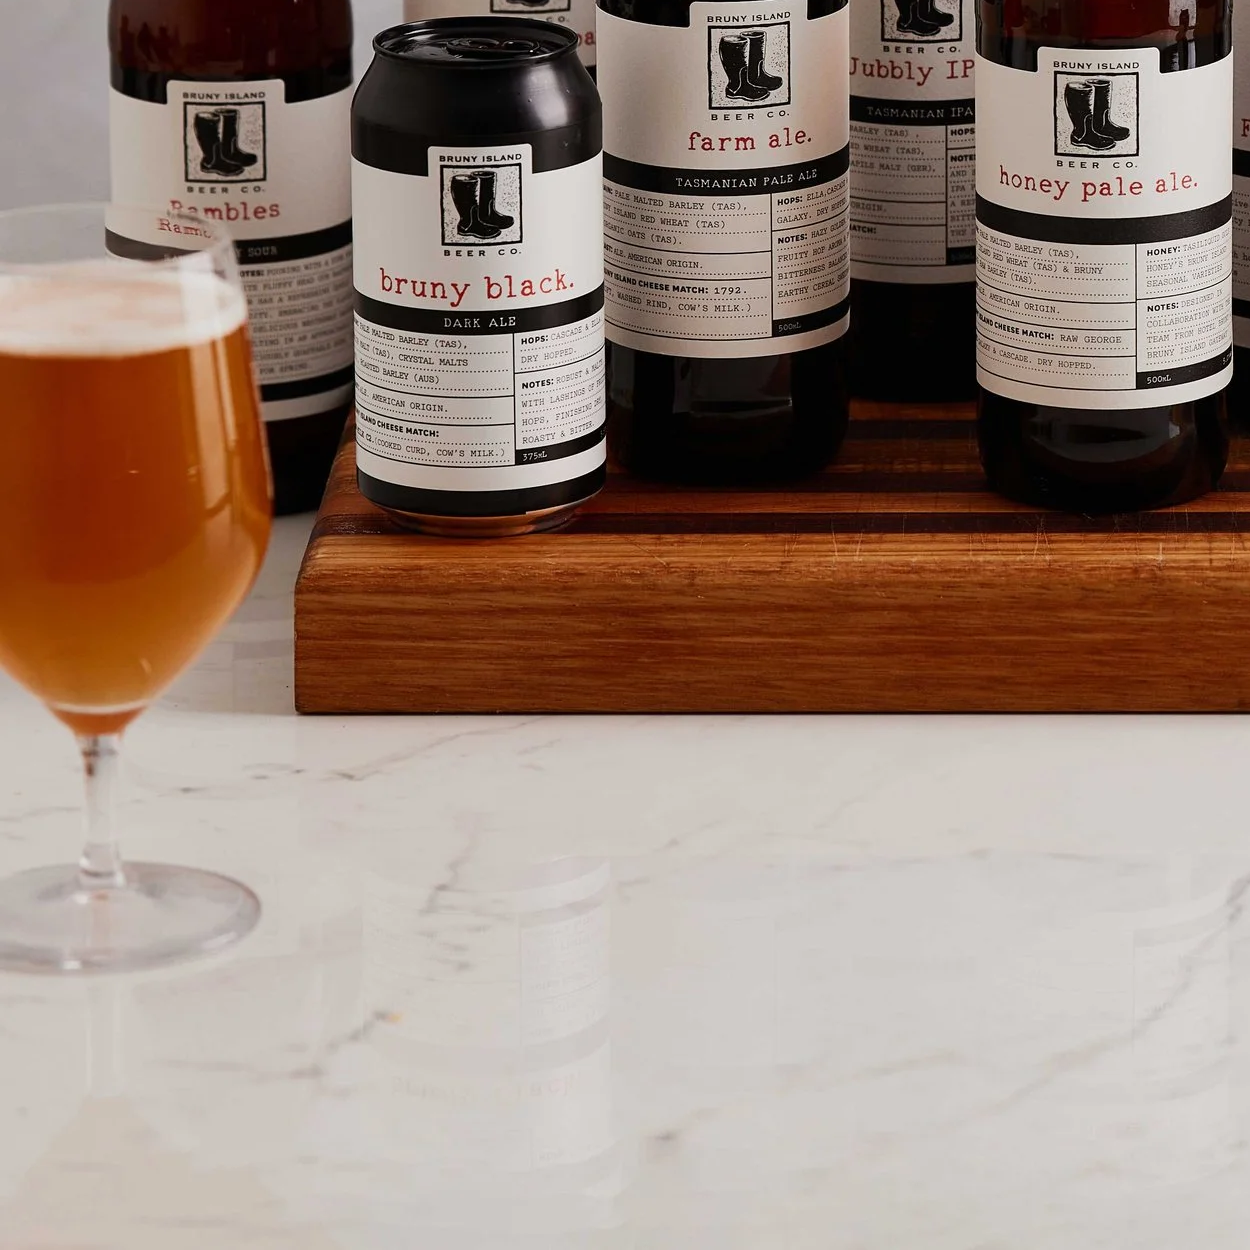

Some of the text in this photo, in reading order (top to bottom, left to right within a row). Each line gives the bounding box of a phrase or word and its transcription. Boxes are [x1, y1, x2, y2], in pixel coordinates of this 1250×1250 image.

[752, 12, 790, 21] ISLAND
[1053, 61, 1092, 69] BRUNY
[849, 57, 975, 86] Jubbly IP
[183, 92, 220, 100] BRUNY
[767, 110, 790, 118] CO.
[867, 106, 973, 118] TASMANIAN IPA
[688, 128, 812, 151] farm ale.
[439, 154, 522, 163] BRUNY ISLAND
[676, 169, 817, 188] TASMANIAN PALE ALE
[1000, 165, 1198, 201] honey pale ale.
[187, 186, 228, 194] BEER
[669, 201, 747, 211] BARLEY (TAS),
[778, 196, 803, 206] HOPS:
[641, 215, 725, 228] RED WHEAT (TAS)
[778, 233, 807, 244] NOTES:
[1015, 243, 1079, 259] BARLEY (TAS),
[1147, 246, 1181, 256] HONEY:
[380, 268, 574, 307] bruny black.
[639, 280, 669, 291] CHEESE
[673, 285, 709, 294] MATCH:
[1147, 302, 1178, 312] NOTES:
[444, 317, 515, 328] DARK ALE
[995, 322, 1019, 334] CHEESE
[1022, 329, 1055, 340] MATCH:
[399, 336, 467, 349] BARLEY (TAS),
[521, 335, 549, 345] HOPS:
[399, 355, 434, 364] CRYSTAL
[521, 348, 577, 363] DRY HOPPED.
[522, 378, 554, 389] NOTES:
[377, 421, 439, 437] CHEESE MATCH:
